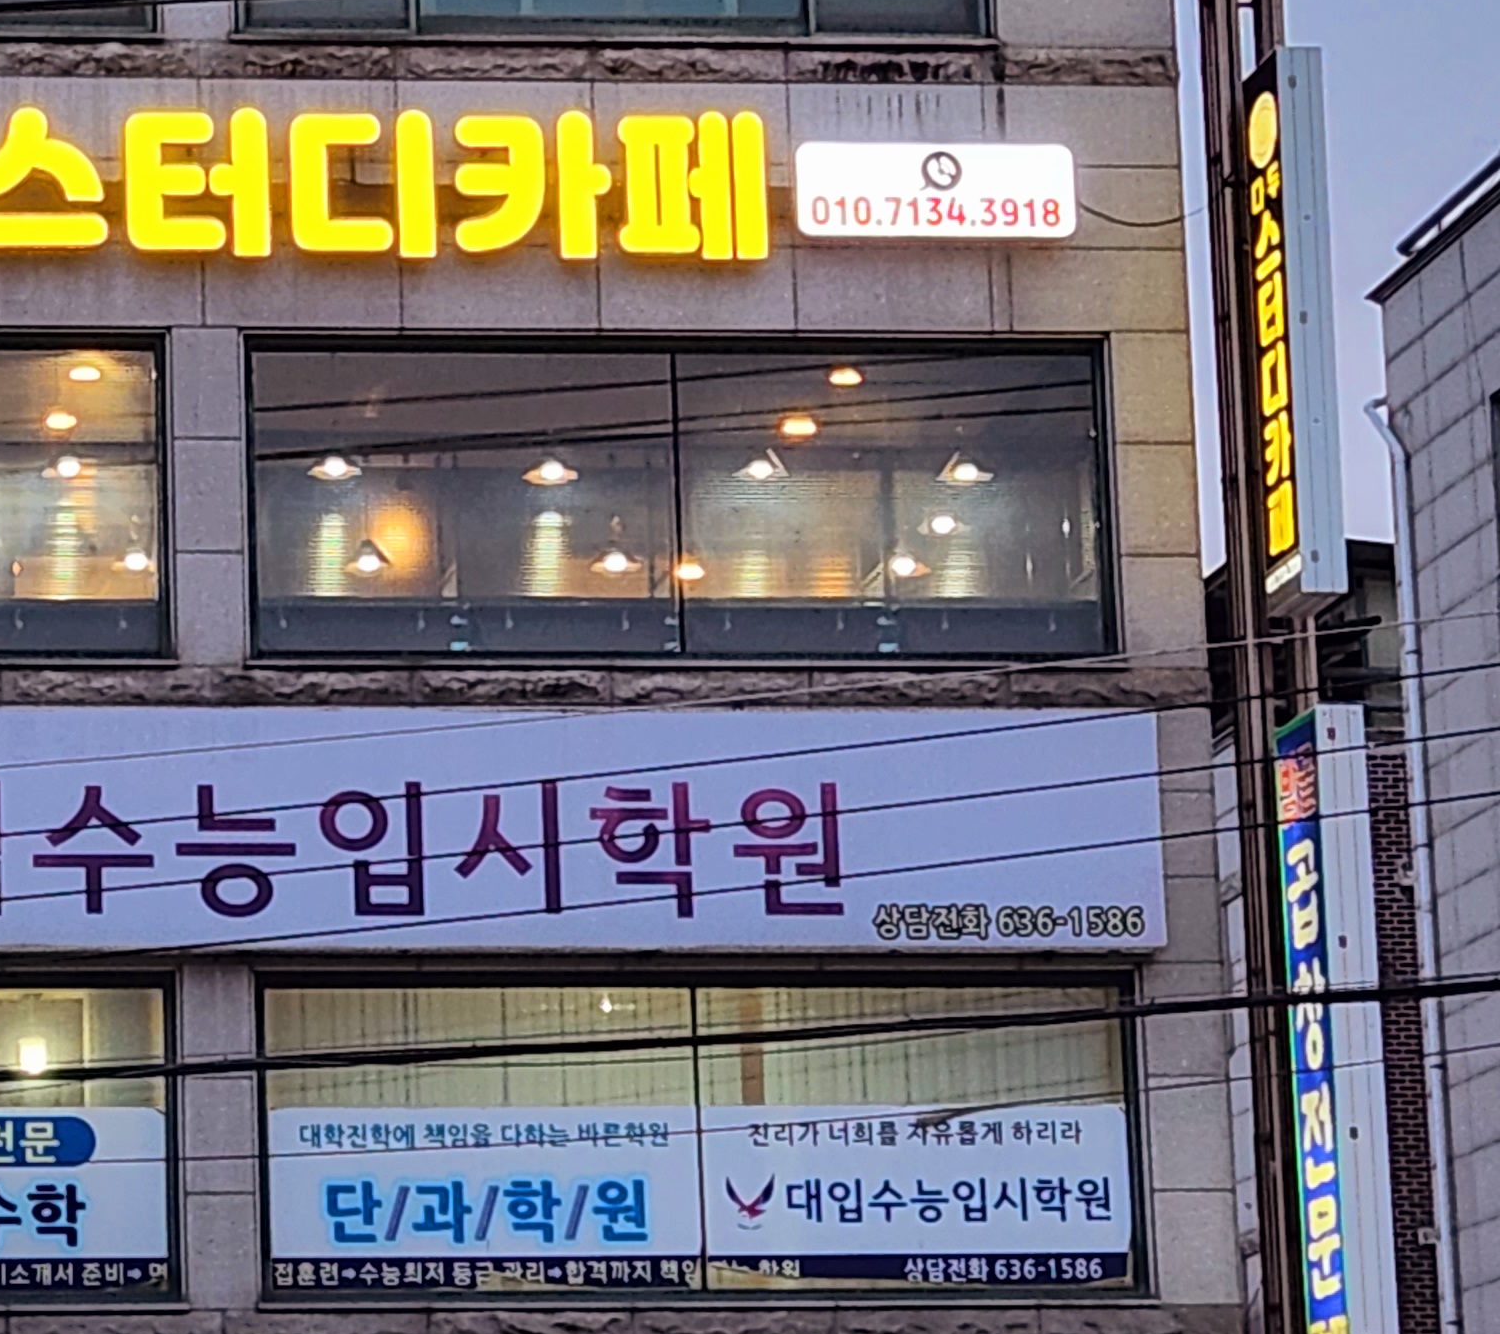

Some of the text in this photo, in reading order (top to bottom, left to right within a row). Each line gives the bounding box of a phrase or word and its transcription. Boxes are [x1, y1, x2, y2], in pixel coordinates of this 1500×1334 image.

[810, 196, 1061, 228] 010.7134.3918
[873, 903, 1146, 941] 상담전화 636-1586
[299, 1122, 670, 1150] 대학진학에 책임을 다하는 바른학원
[747, 1119, 1083, 1148] 진리가 너희를 자유롭게 하리라
[785, 1175, 1113, 1224] 대입수능입시학원
[81, 1262, 126, 1286] 준비
[358, 1261, 445, 1286] 수능최저
[903, 1257, 1103, 1284] 상담전화 636-1586
